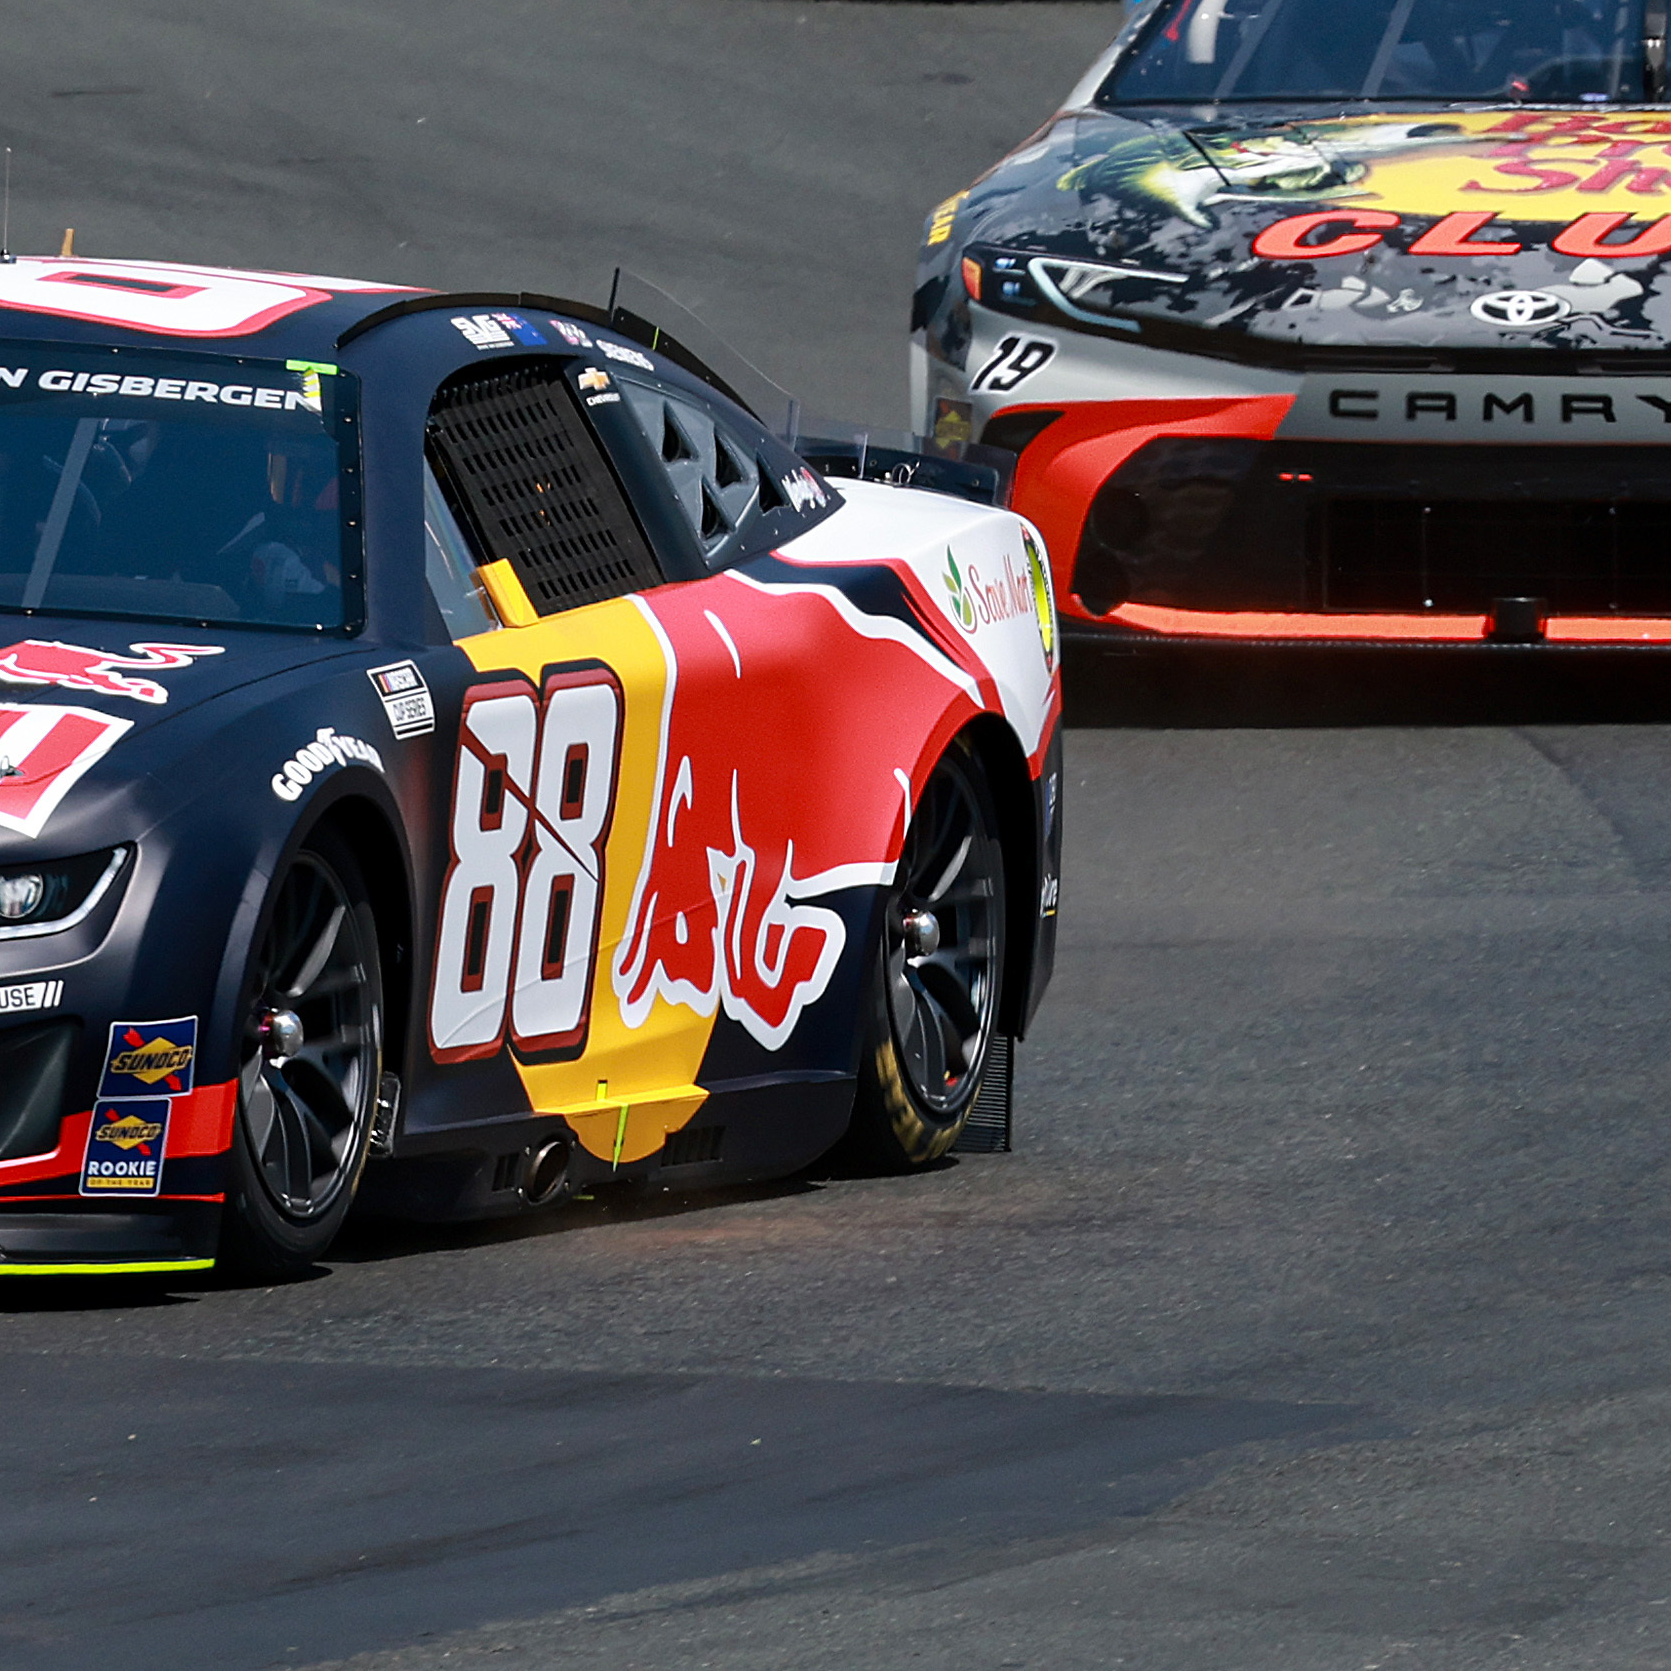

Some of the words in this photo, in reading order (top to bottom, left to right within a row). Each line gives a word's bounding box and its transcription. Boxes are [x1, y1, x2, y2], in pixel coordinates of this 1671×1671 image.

[968, 333, 1058, 394] 19
[271, 726, 385, 802] GOODYEAR
[430, 664, 623, 1065] 88
[113, 1046, 193, 1072] SUNOCO
[97, 1123, 162, 1140] SUNOCO
[87, 1160, 157, 1176] ROOKIE
